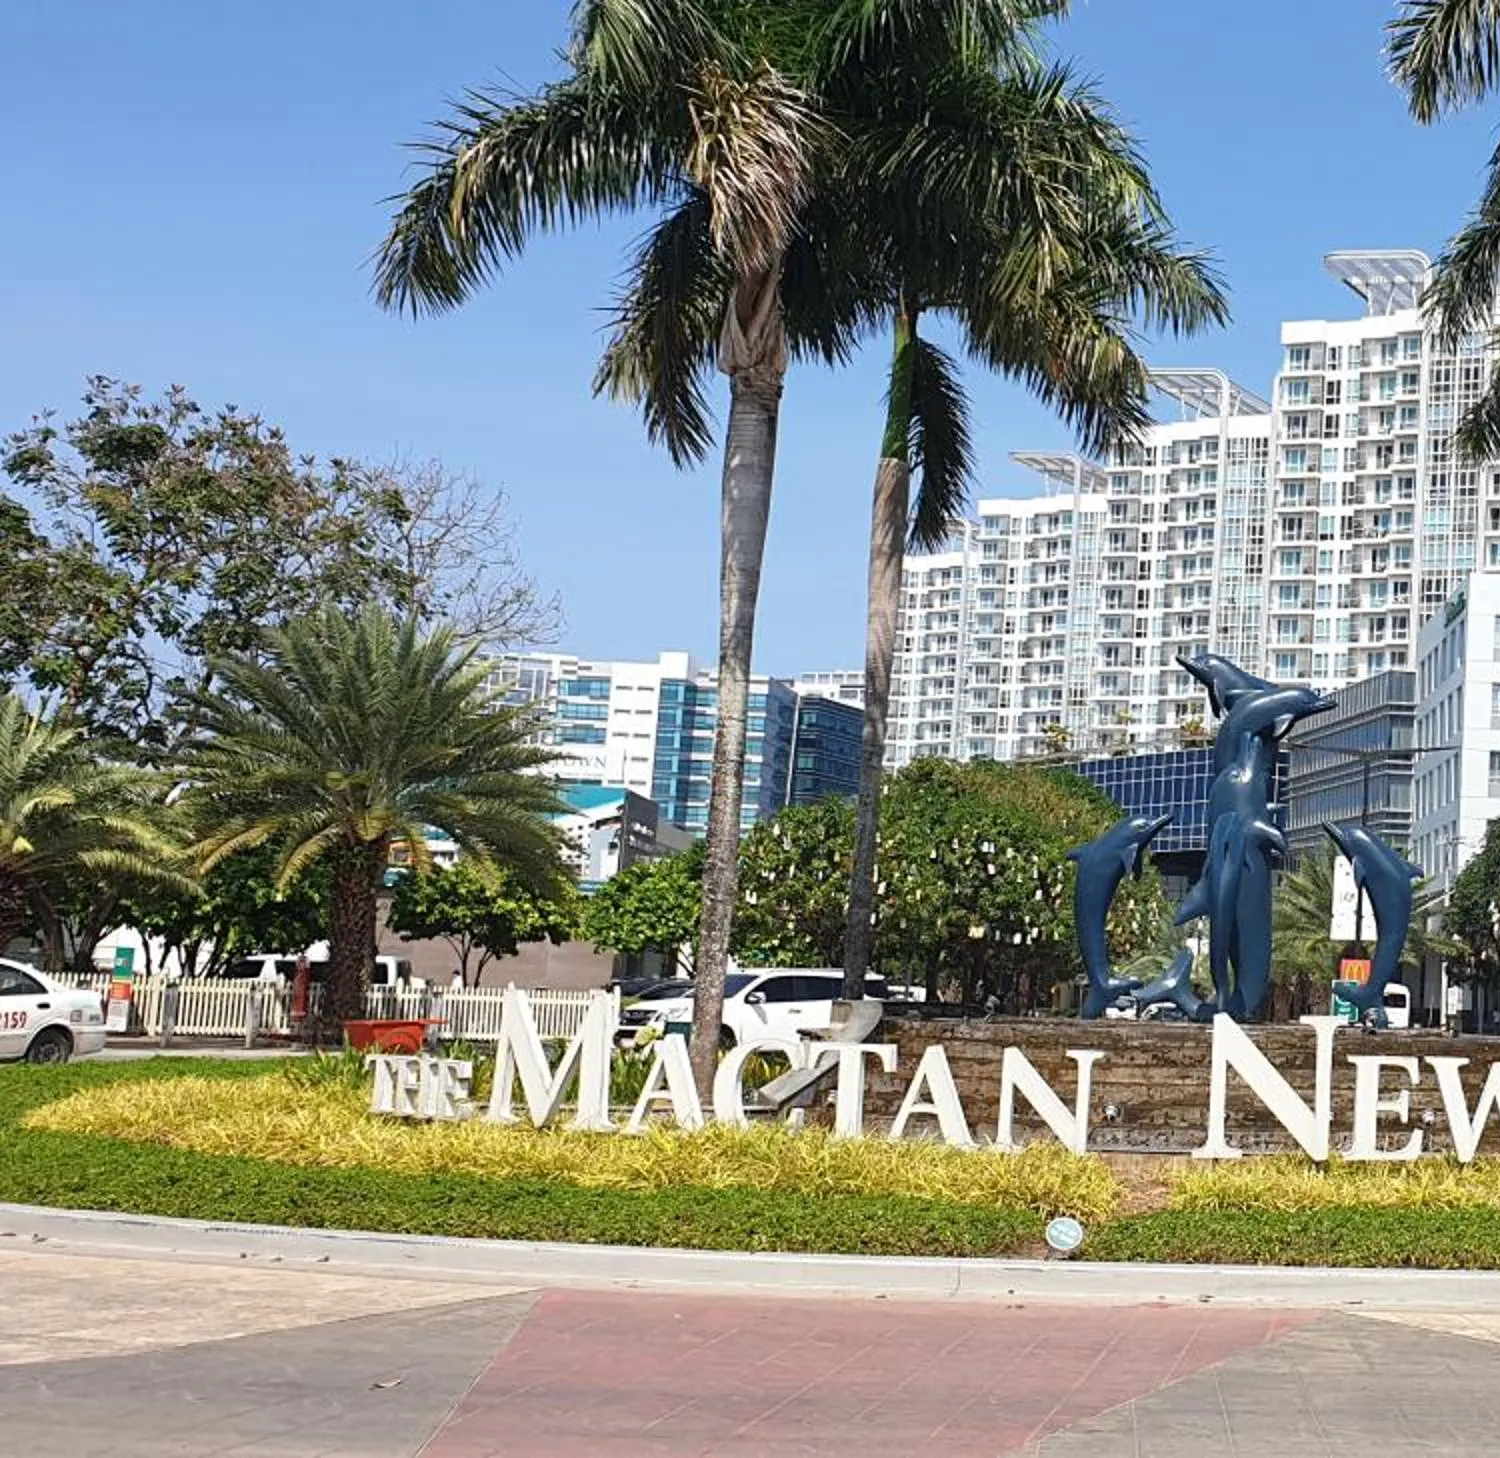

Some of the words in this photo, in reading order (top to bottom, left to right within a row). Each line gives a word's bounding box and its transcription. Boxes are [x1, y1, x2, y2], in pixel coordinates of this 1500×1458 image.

[0, 1011, 28, 1029] 159
[362, 1053, 473, 1120] THE
[486, 981, 1105, 1154] MACTAN
